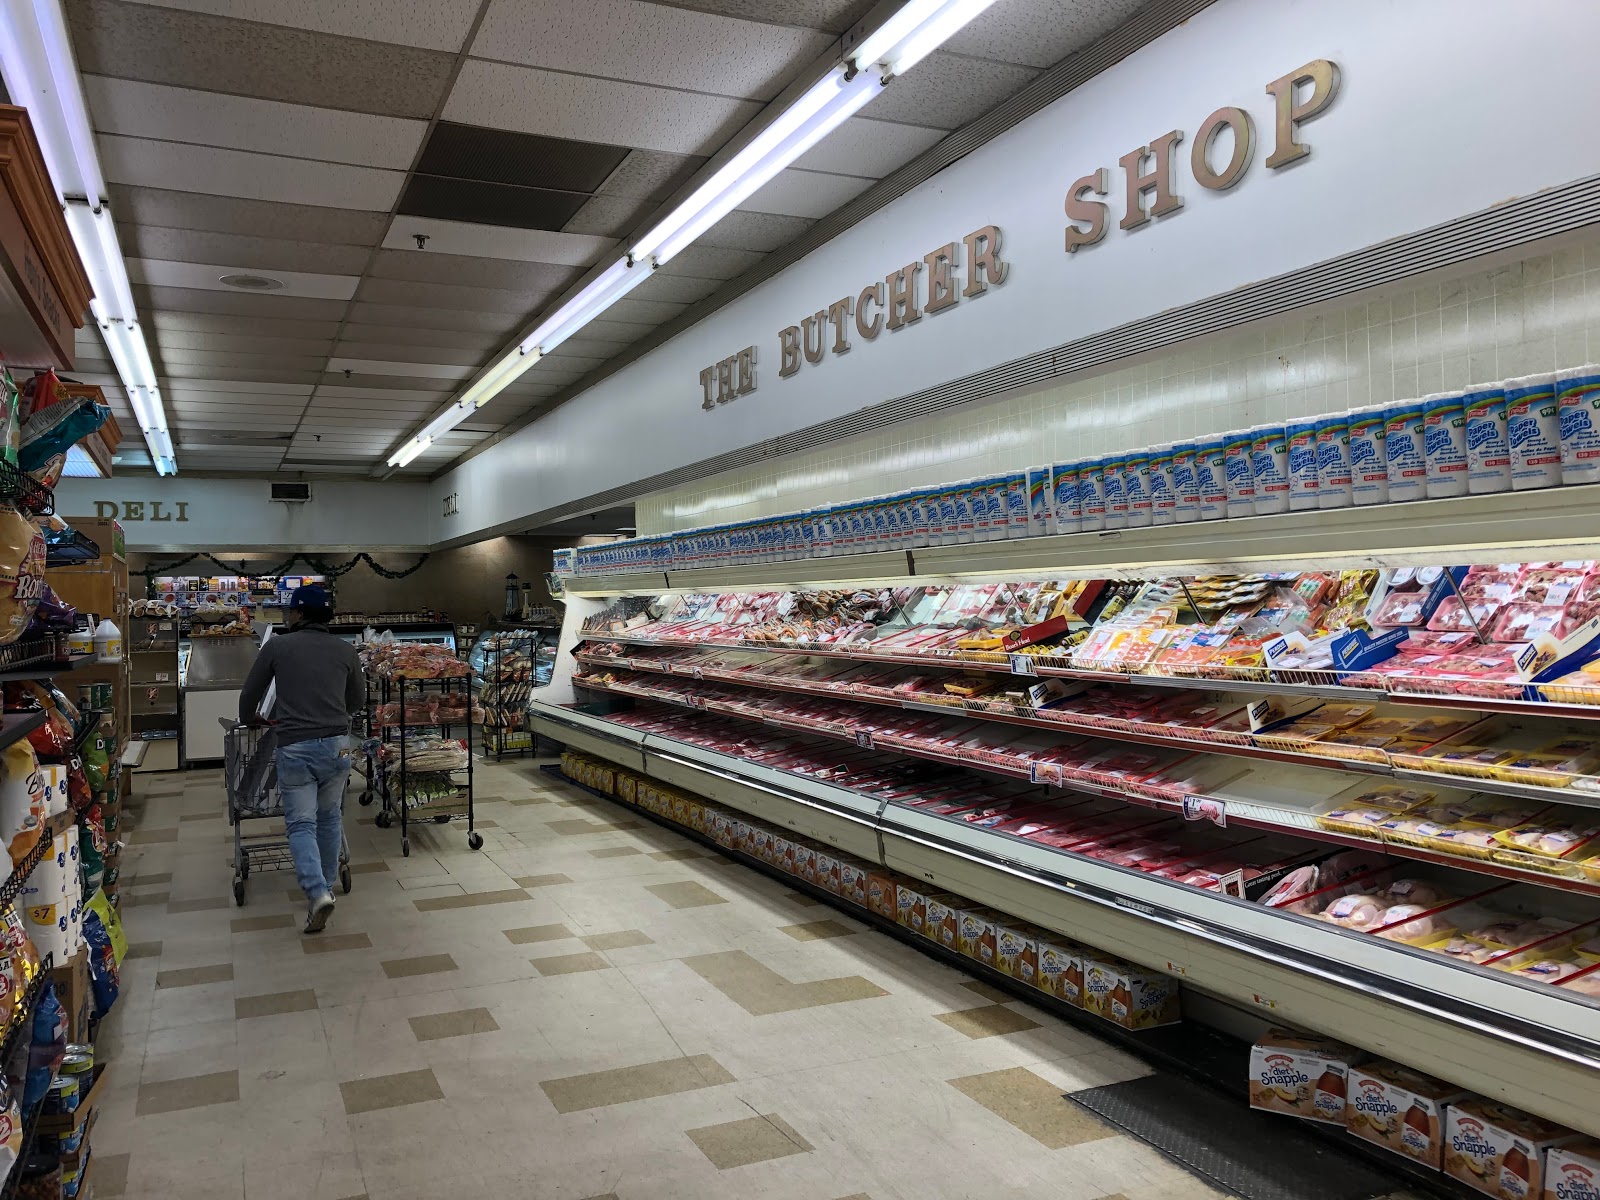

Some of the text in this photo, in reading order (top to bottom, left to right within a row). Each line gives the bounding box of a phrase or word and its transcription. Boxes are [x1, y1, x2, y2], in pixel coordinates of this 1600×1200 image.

[699, 59, 1341, 410] THE BUTCHER SHOP
[1509, 418, 1536, 435] Paper
[1560, 409, 1588, 429] Paper
[1425, 428, 1449, 446] Paper
[1468, 421, 1495, 438] Paper
[1386, 434, 1411, 450] Paper
[1468, 430, 1498, 450] Towels
[1509, 427, 1540, 449] Towels
[1291, 449, 1314, 463] Paper
[1387, 442, 1414, 461] Towels
[94, 500, 189, 522] DELI
[1268, 640, 1287, 656] PERDUE
[34, 907, 50, 920] $7
[1000, 944, 1019, 957] Snapple
[1042, 963, 1062, 975] Snapple
[1087, 980, 1110, 994] Snapple
[1140, 990, 1167, 1010] Snapple
[1261, 1071, 1309, 1087] Snapple
[1273, 1068, 1290, 1076] diet
[1315, 1101, 1342, 1111] Snapple
[1355, 1097, 1398, 1116] Snapple
[1366, 1094, 1381, 1103] diet
[1464, 1133, 1479, 1143] diet
[1453, 1136, 1496, 1158] Snapple
[1557, 1183, 1600, 1200] Snappl
[1570, 1180, 1588, 1191] diet
